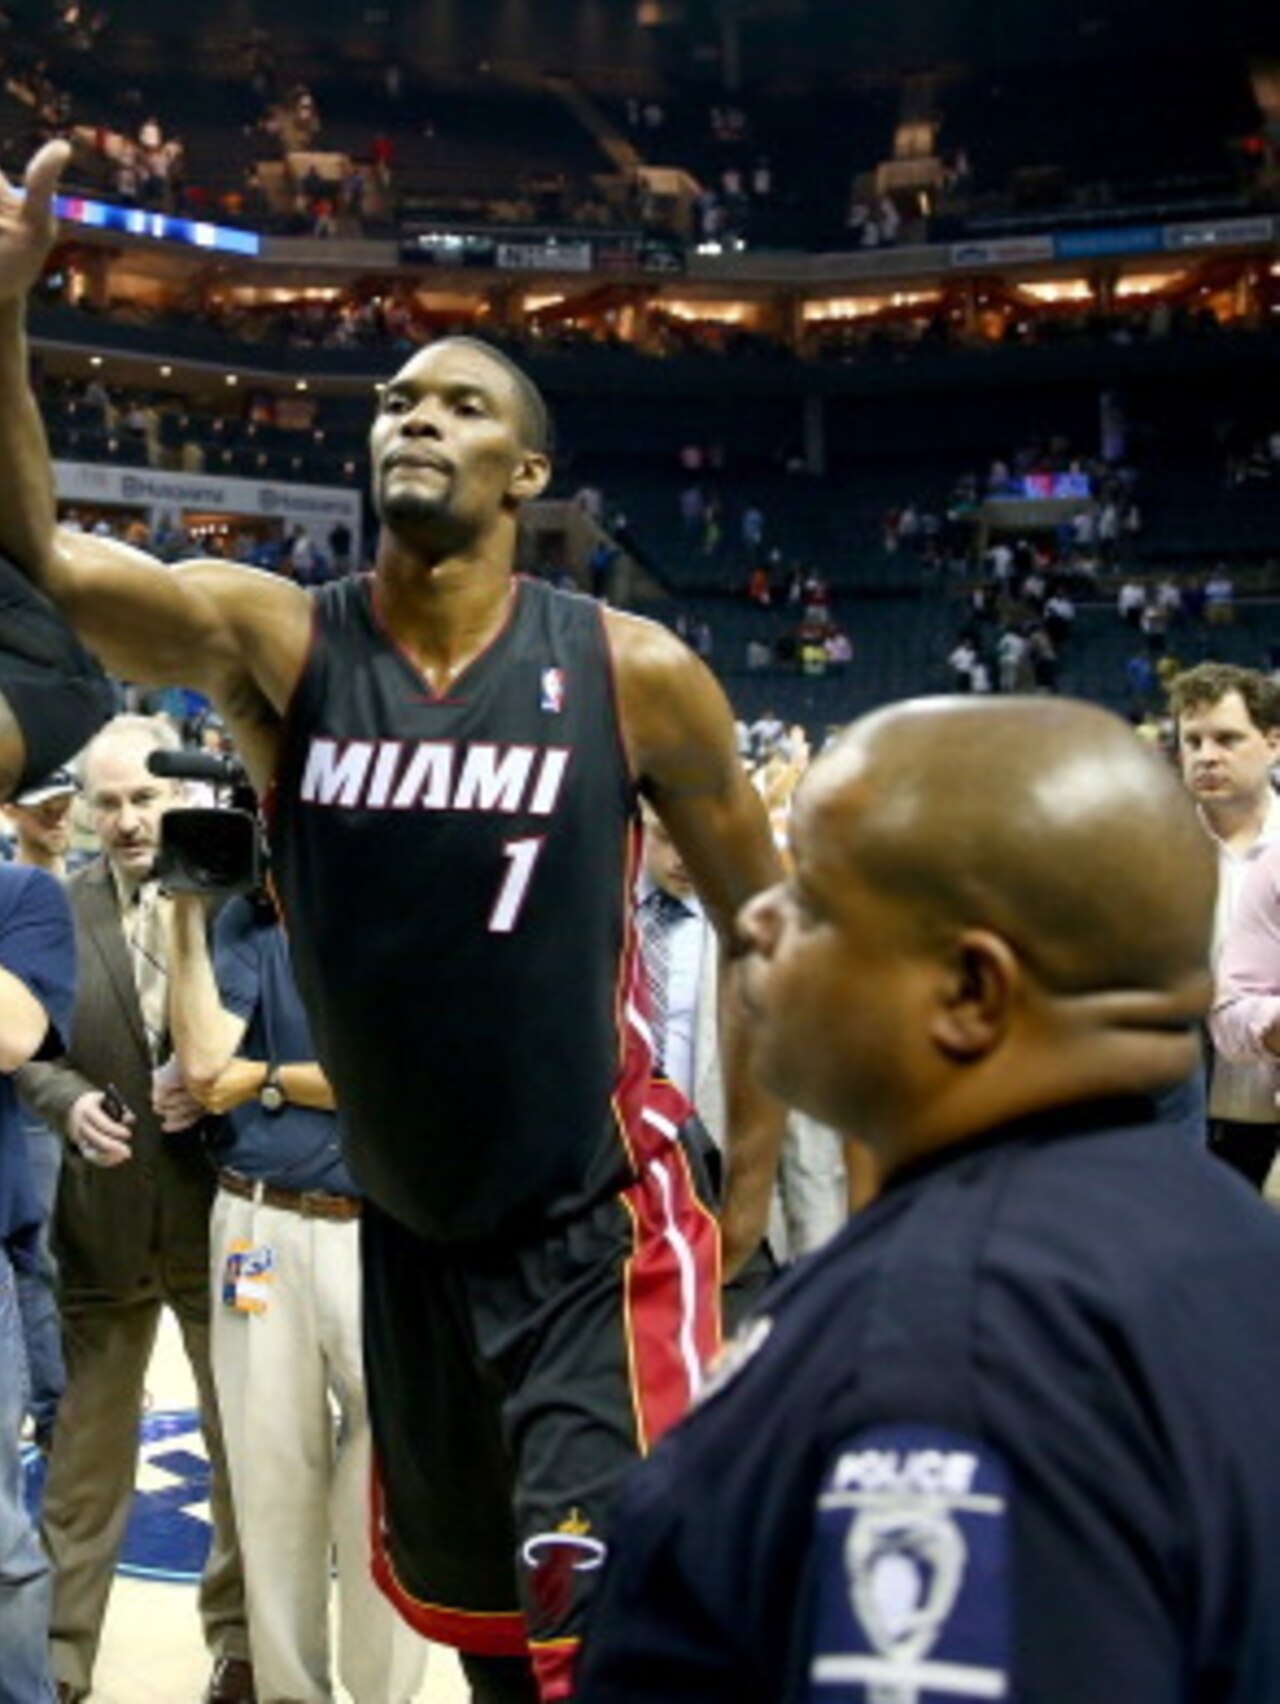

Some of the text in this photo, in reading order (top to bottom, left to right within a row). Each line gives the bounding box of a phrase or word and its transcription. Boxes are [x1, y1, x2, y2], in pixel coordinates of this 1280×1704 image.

[299, 737, 571, 816] MIAMI
[486, 834, 547, 933] 1
[832, 1449, 978, 1494] POLICE
